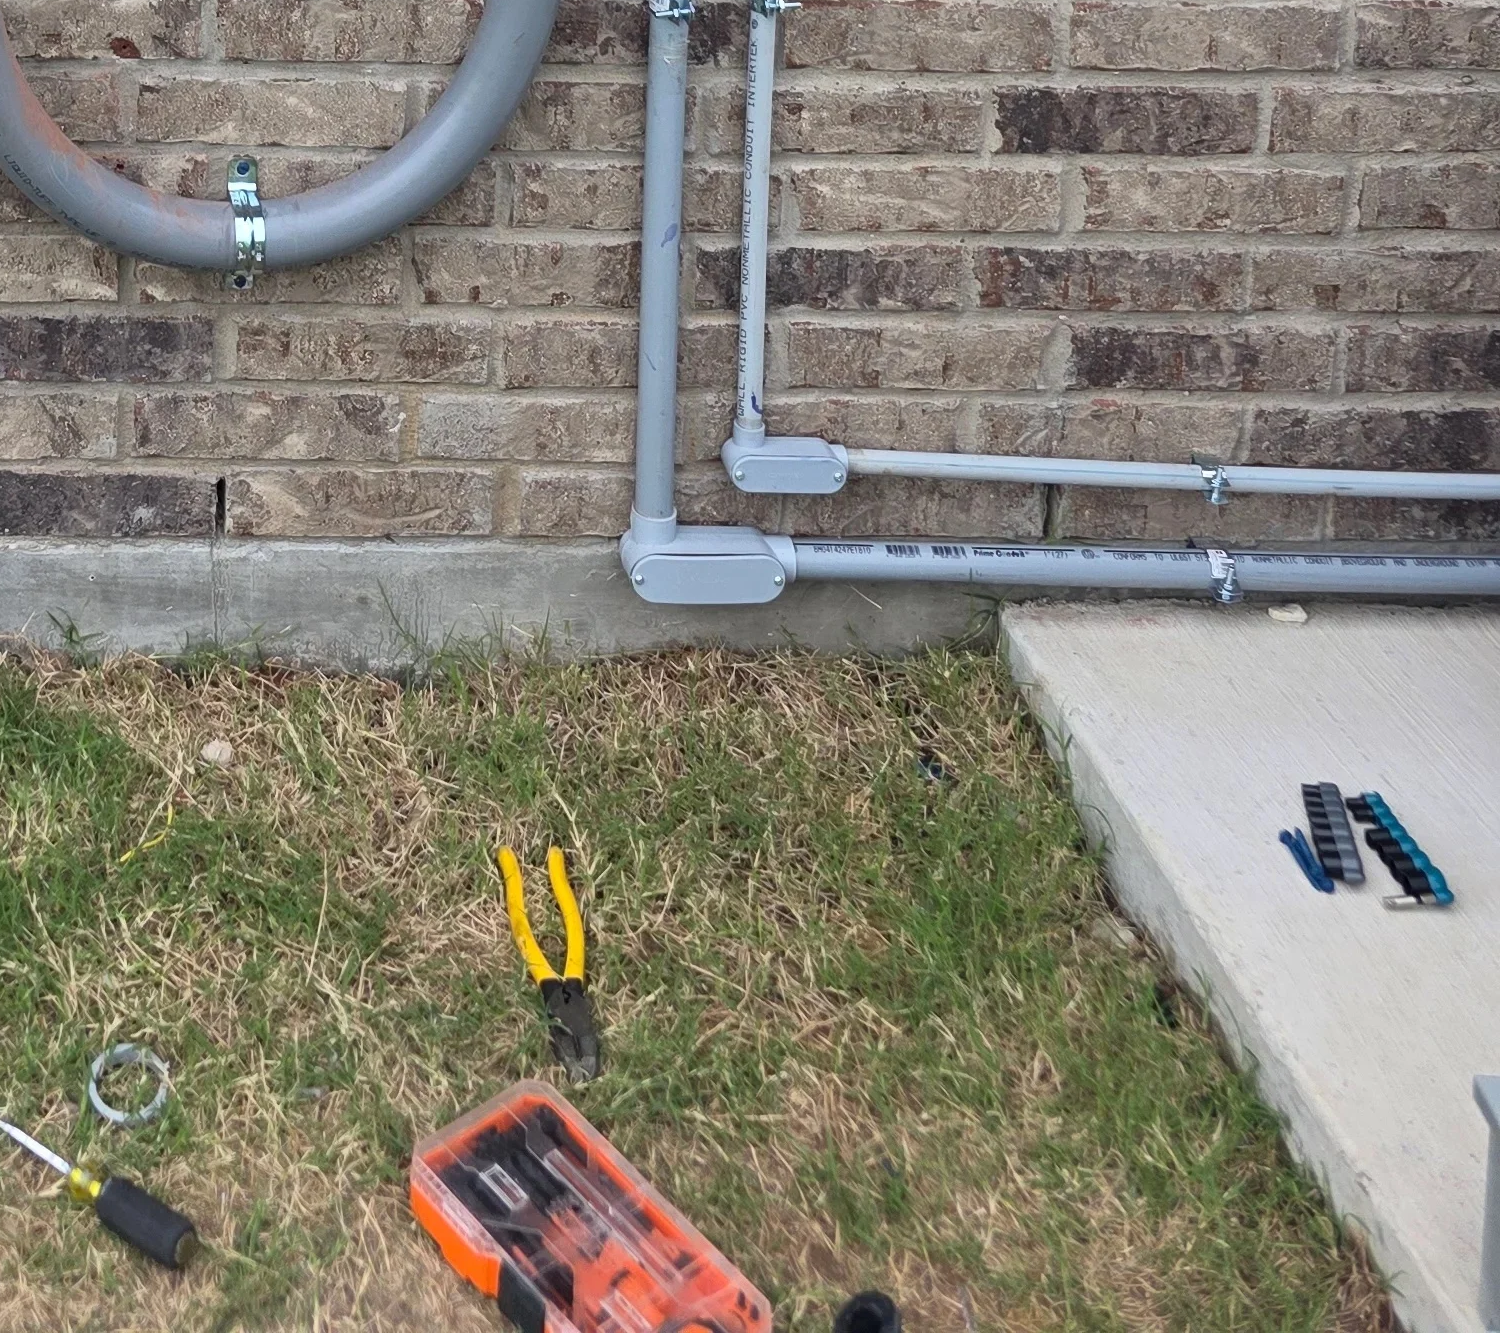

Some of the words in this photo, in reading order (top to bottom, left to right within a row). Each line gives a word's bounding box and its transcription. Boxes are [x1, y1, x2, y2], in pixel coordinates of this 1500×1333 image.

[747, 38, 758, 107] INTERTEK
[744, 118, 755, 180] CONDUIT
[741, 188, 752, 285] NONMETALLIC
[740, 293, 748, 320] PVC
[739, 329, 748, 372] RIGID
[738, 383, 746, 417] WALL
